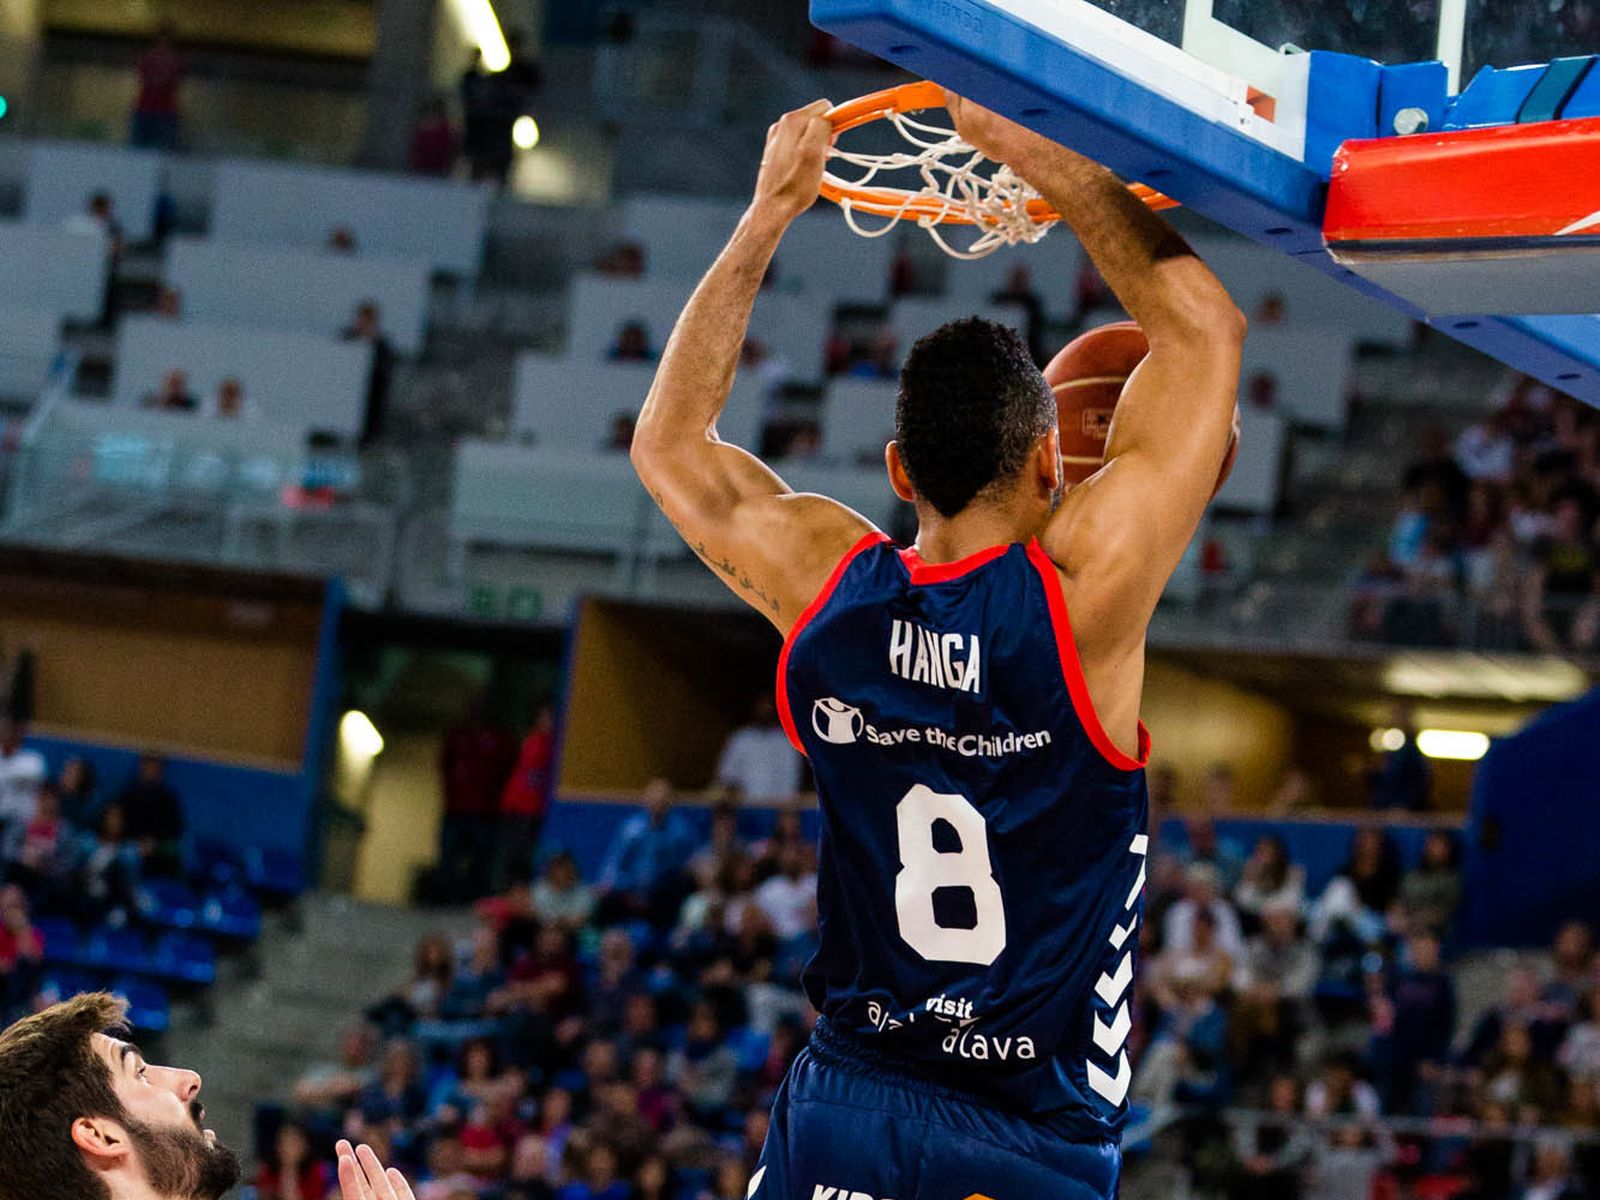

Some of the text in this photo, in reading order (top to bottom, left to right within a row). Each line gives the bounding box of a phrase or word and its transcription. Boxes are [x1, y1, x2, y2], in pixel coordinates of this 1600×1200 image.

[889, 619, 980, 694] HANGA
[865, 724, 1052, 757] Save the Children
[895, 783, 1007, 966] 8
[926, 993, 974, 1019] visit
